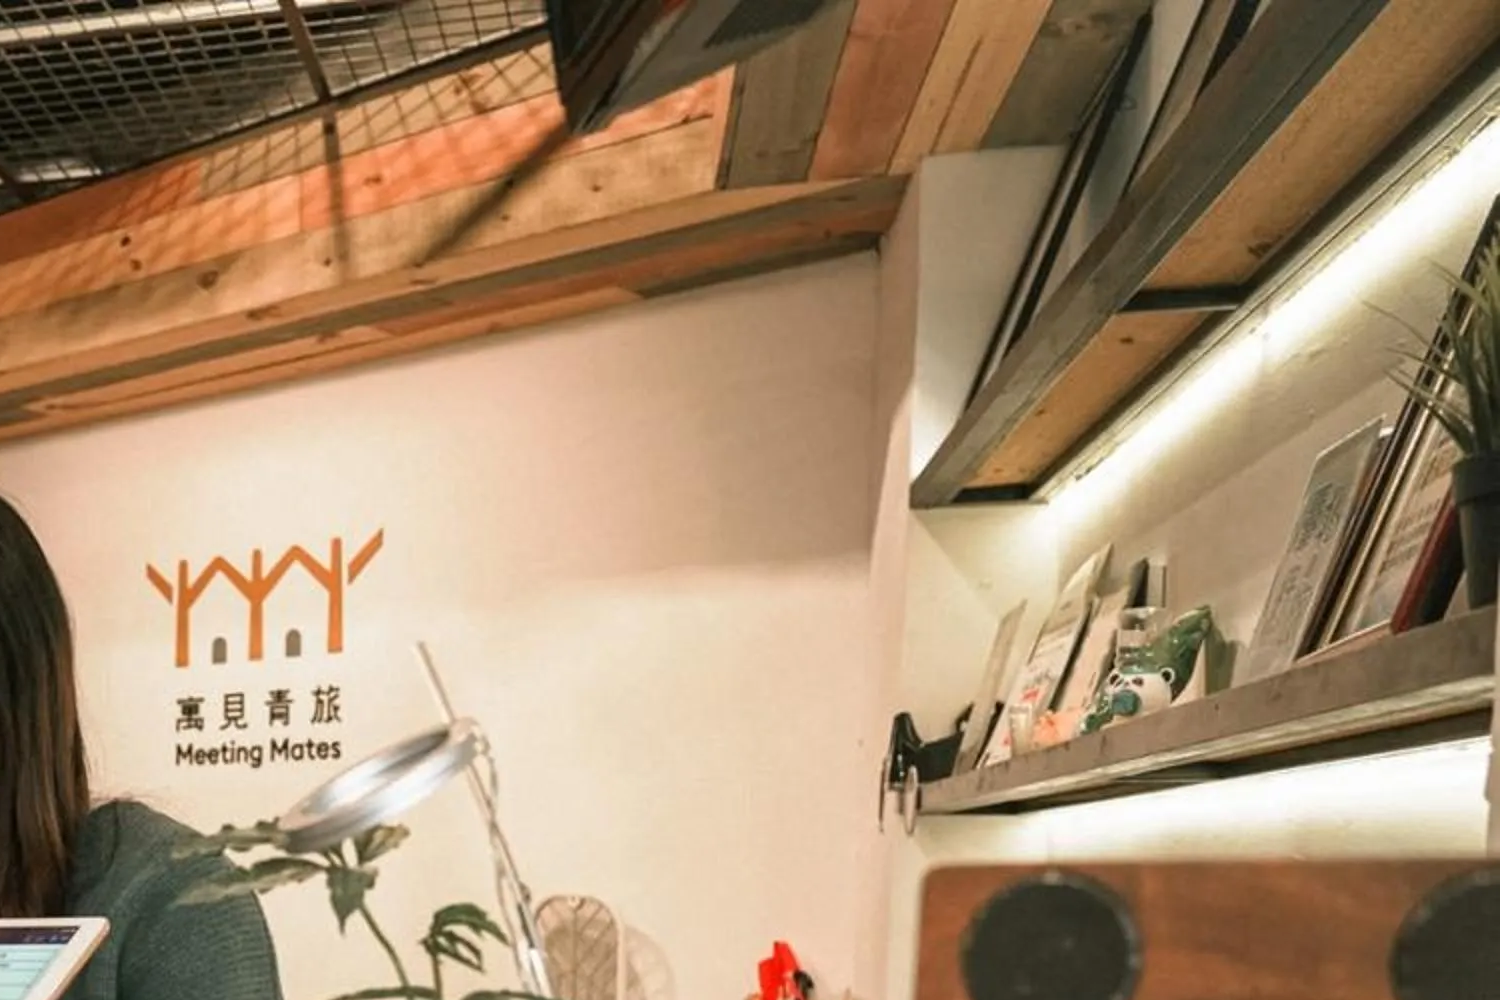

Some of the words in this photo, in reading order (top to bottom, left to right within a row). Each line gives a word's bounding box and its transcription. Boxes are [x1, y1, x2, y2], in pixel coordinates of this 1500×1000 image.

[175, 684, 342, 731] 寓見青旅
[175, 740, 263, 768] Meeting
[269, 737, 342, 762] Mates
